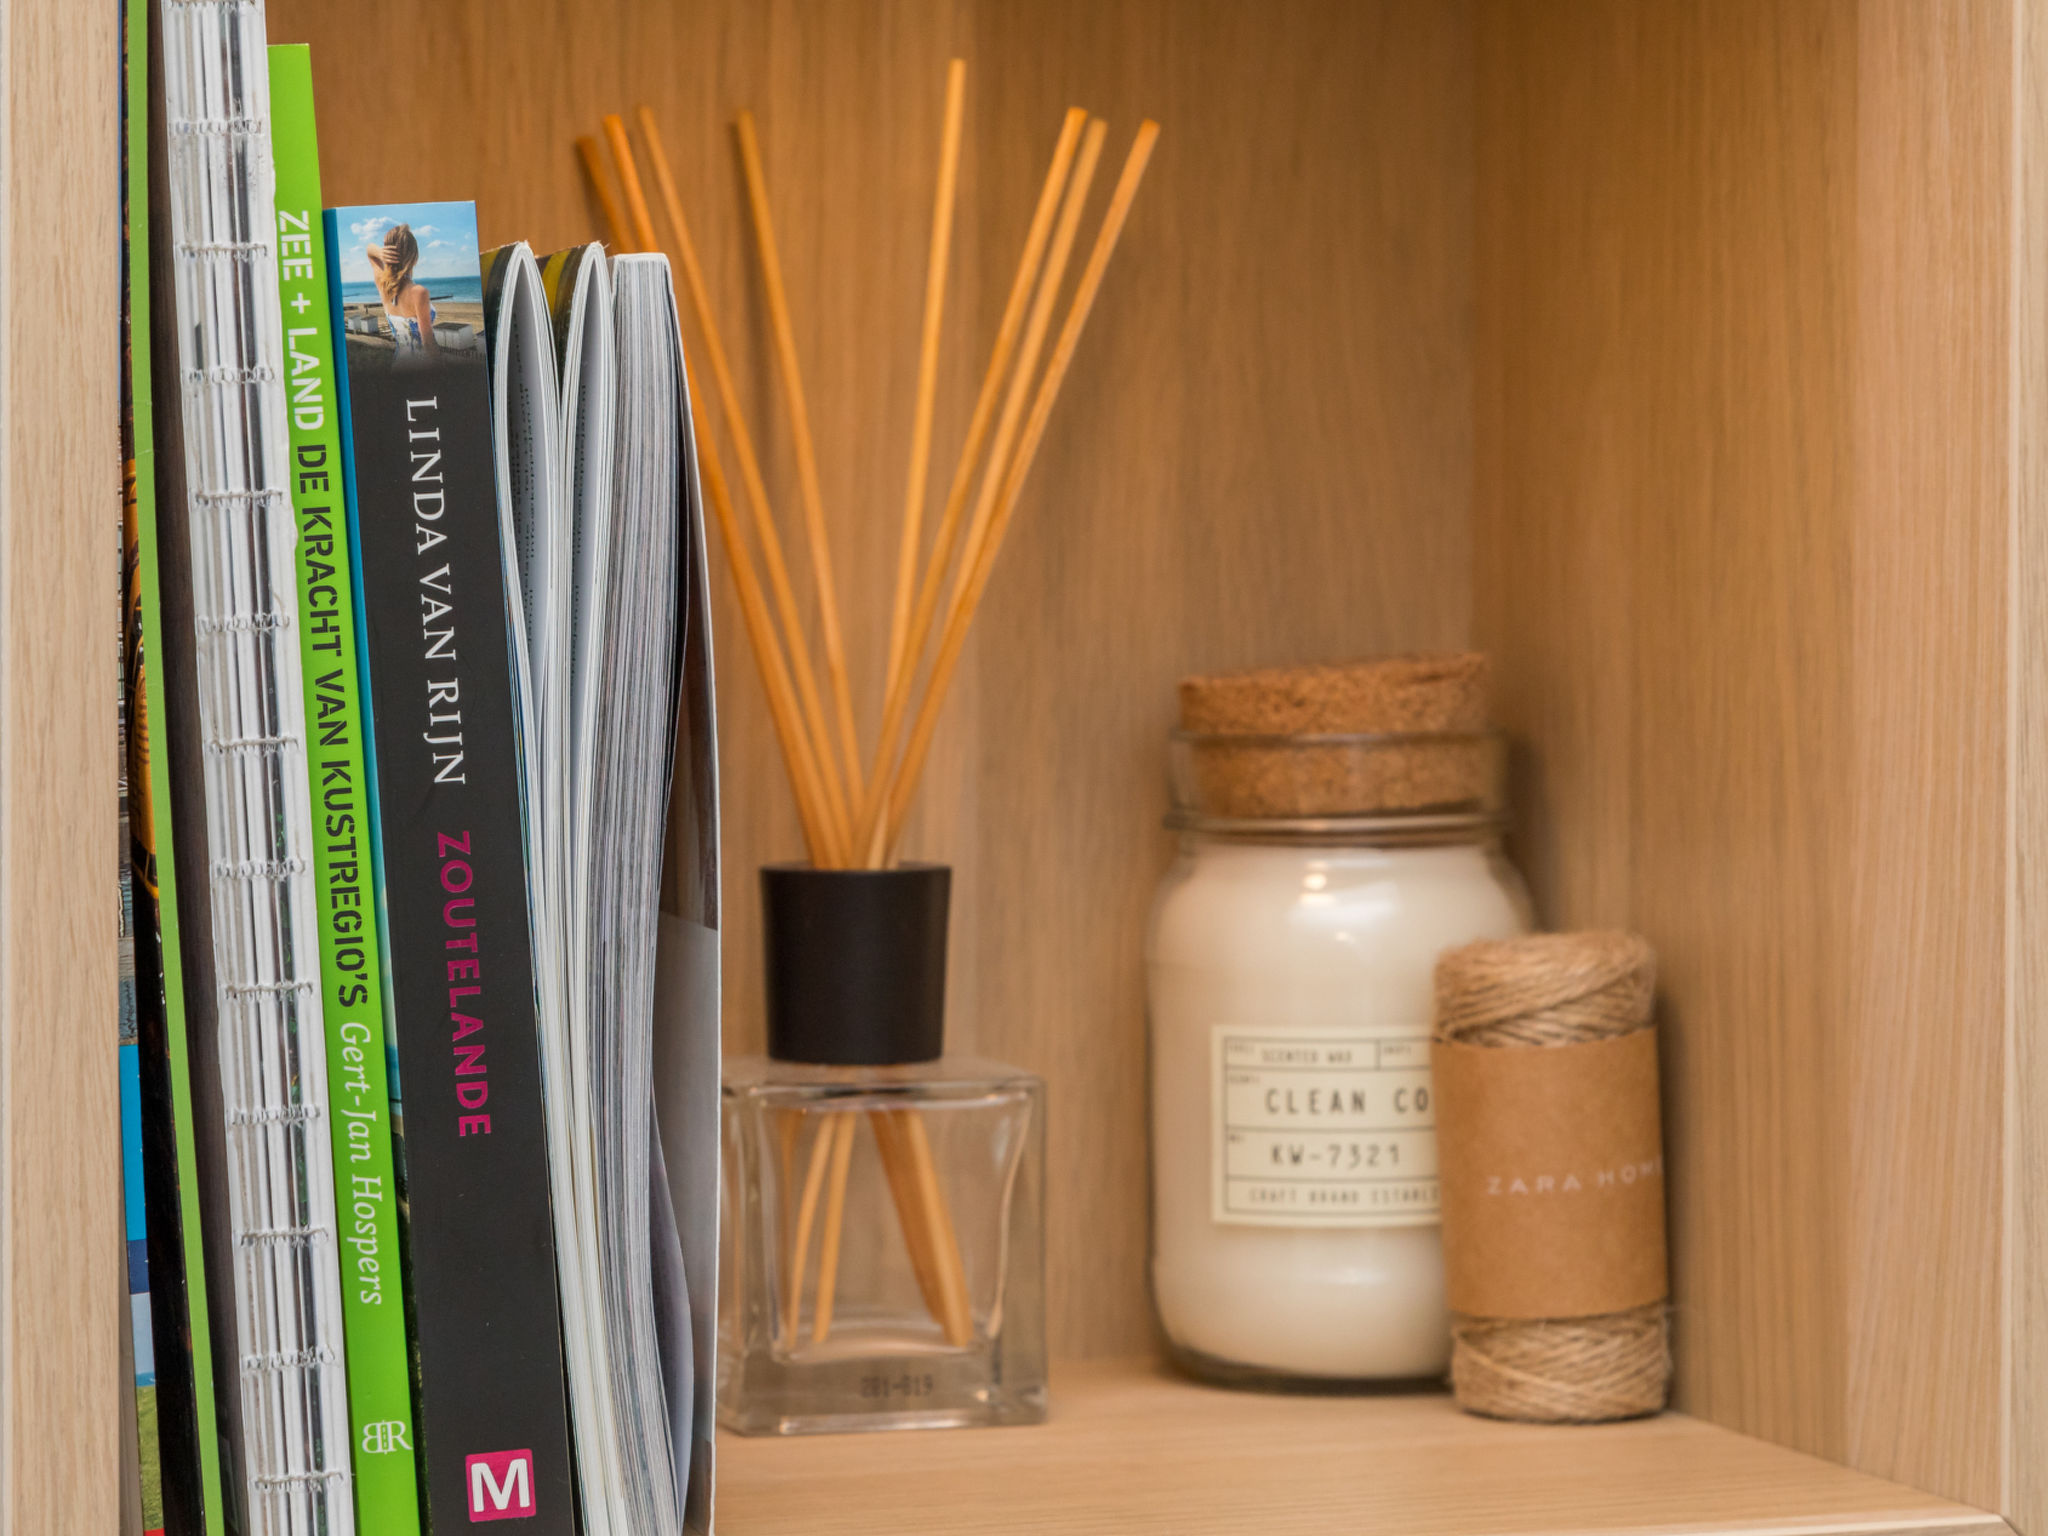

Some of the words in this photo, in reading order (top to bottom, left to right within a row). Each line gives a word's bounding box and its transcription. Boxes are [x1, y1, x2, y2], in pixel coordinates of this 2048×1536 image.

[279, 210, 314, 282] ZEE
[290, 292, 311, 314] +
[287, 327, 324, 430] LAND
[297, 444, 330, 494] DE
[406, 396, 448, 555] LINDA
[302, 507, 342, 657] KRACHT
[419, 563, 457, 660] VAN
[314, 668, 348, 746] VAN
[424, 677, 466, 785] RIJN
[321, 760, 368, 1008] KUSTREGIO'S
[437, 830, 492, 1137] ZOUTELANDE
[340, 1022, 377, 1163] Gert-Jan
[1265, 1087, 1367, 1115] CLEAN
[1270, 1142, 1401, 1170] KW-7321
[1486, 1172, 1583, 1196] ZARA
[347, 1173, 383, 1305] Hospers
[471, 1458, 531, 1513] M
